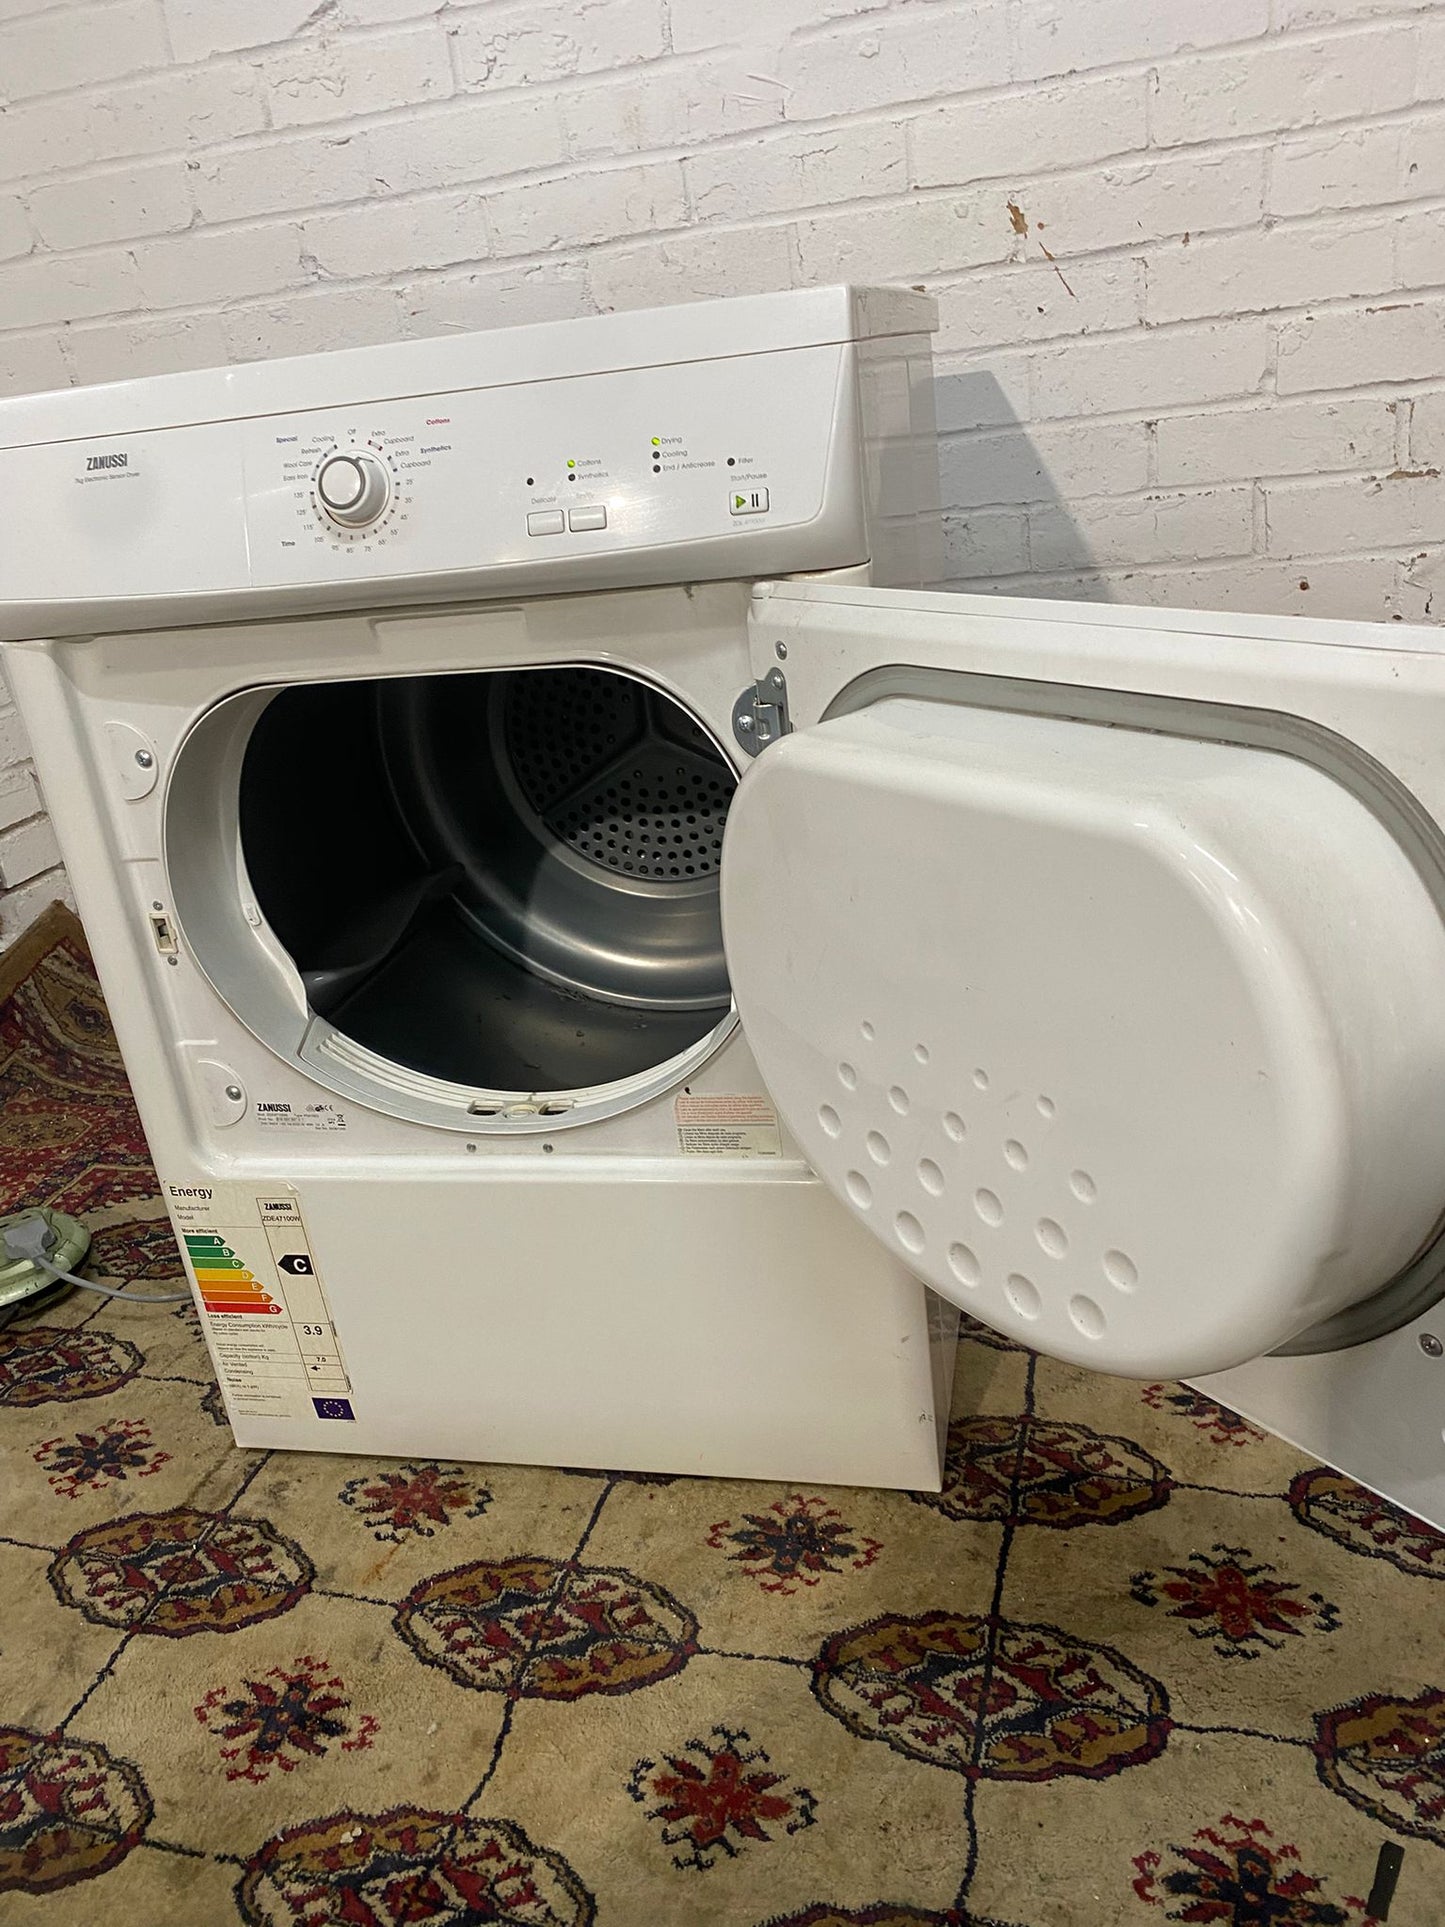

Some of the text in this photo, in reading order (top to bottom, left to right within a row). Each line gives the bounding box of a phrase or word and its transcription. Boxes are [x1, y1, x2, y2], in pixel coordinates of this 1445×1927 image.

[86, 453, 128, 471] ZANUSSI
[257, 1103, 291, 1112] ZANUSSI
[169, 1185, 212, 1200] Energy
[263, 1202, 293, 1210] ZANUSSI
[213, 1237, 221, 1245] A
[222, 1248, 230, 1256] B
[231, 1260, 240, 1268] C
[293, 1258, 307, 1273] C
[241, 1270, 249, 1279] D
[251, 1282, 259, 1291] E
[261, 1294, 268, 1302] F
[269, 1304, 278, 1313] G
[303, 1325, 323, 1336] 3.9
